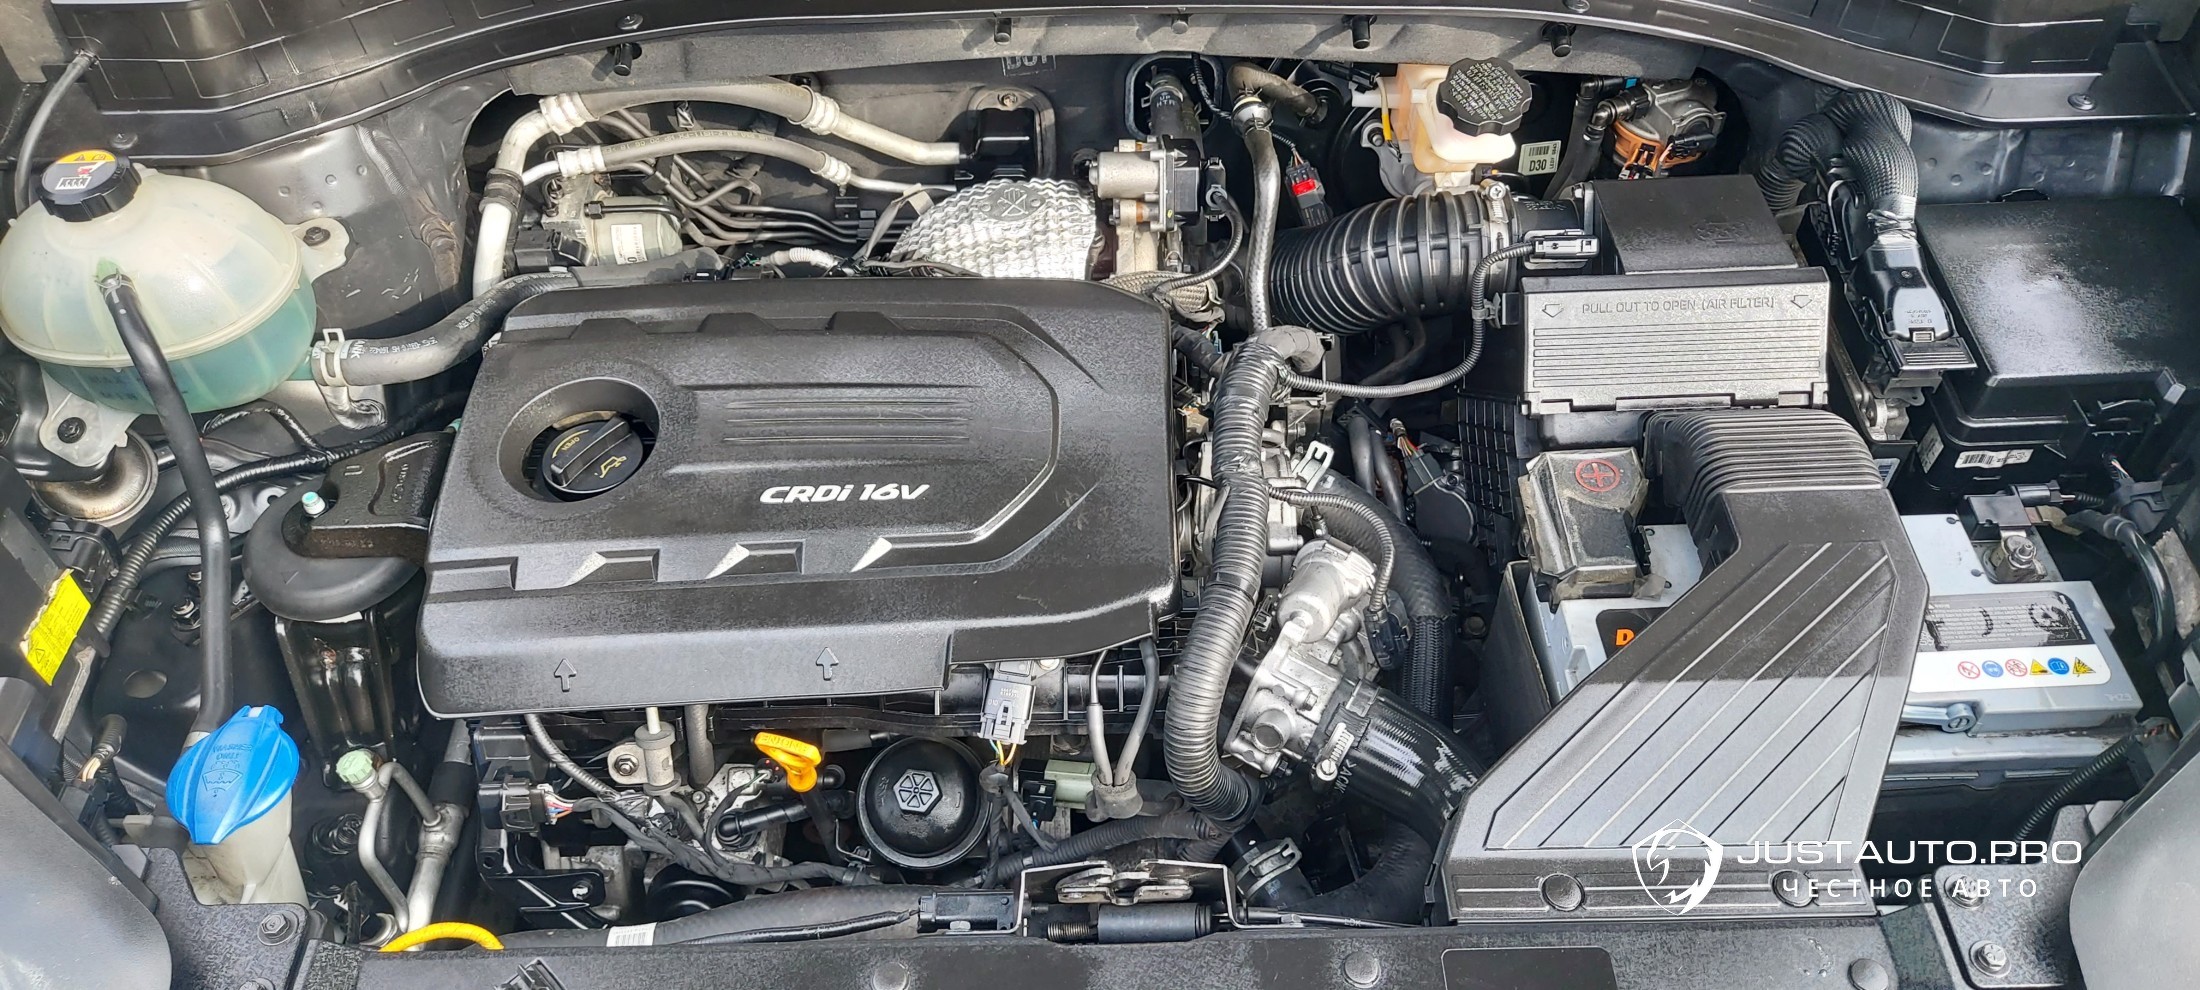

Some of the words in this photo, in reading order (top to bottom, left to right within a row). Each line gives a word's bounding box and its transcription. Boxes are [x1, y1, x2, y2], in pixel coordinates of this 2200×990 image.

[1529, 159, 1547, 172] D30
[1582, 302, 1613, 314] PULL
[1615, 301, 1639, 313] OUT
[1645, 301, 1660, 312] TO
[1663, 299, 1696, 311] OPEN
[1702, 298, 1727, 311] (AIR
[1730, 296, 1776, 310] FILTER)
[561, 436, 581, 452] OPEN
[760, 484, 857, 504] CRDi
[860, 483, 930, 502] 16V
